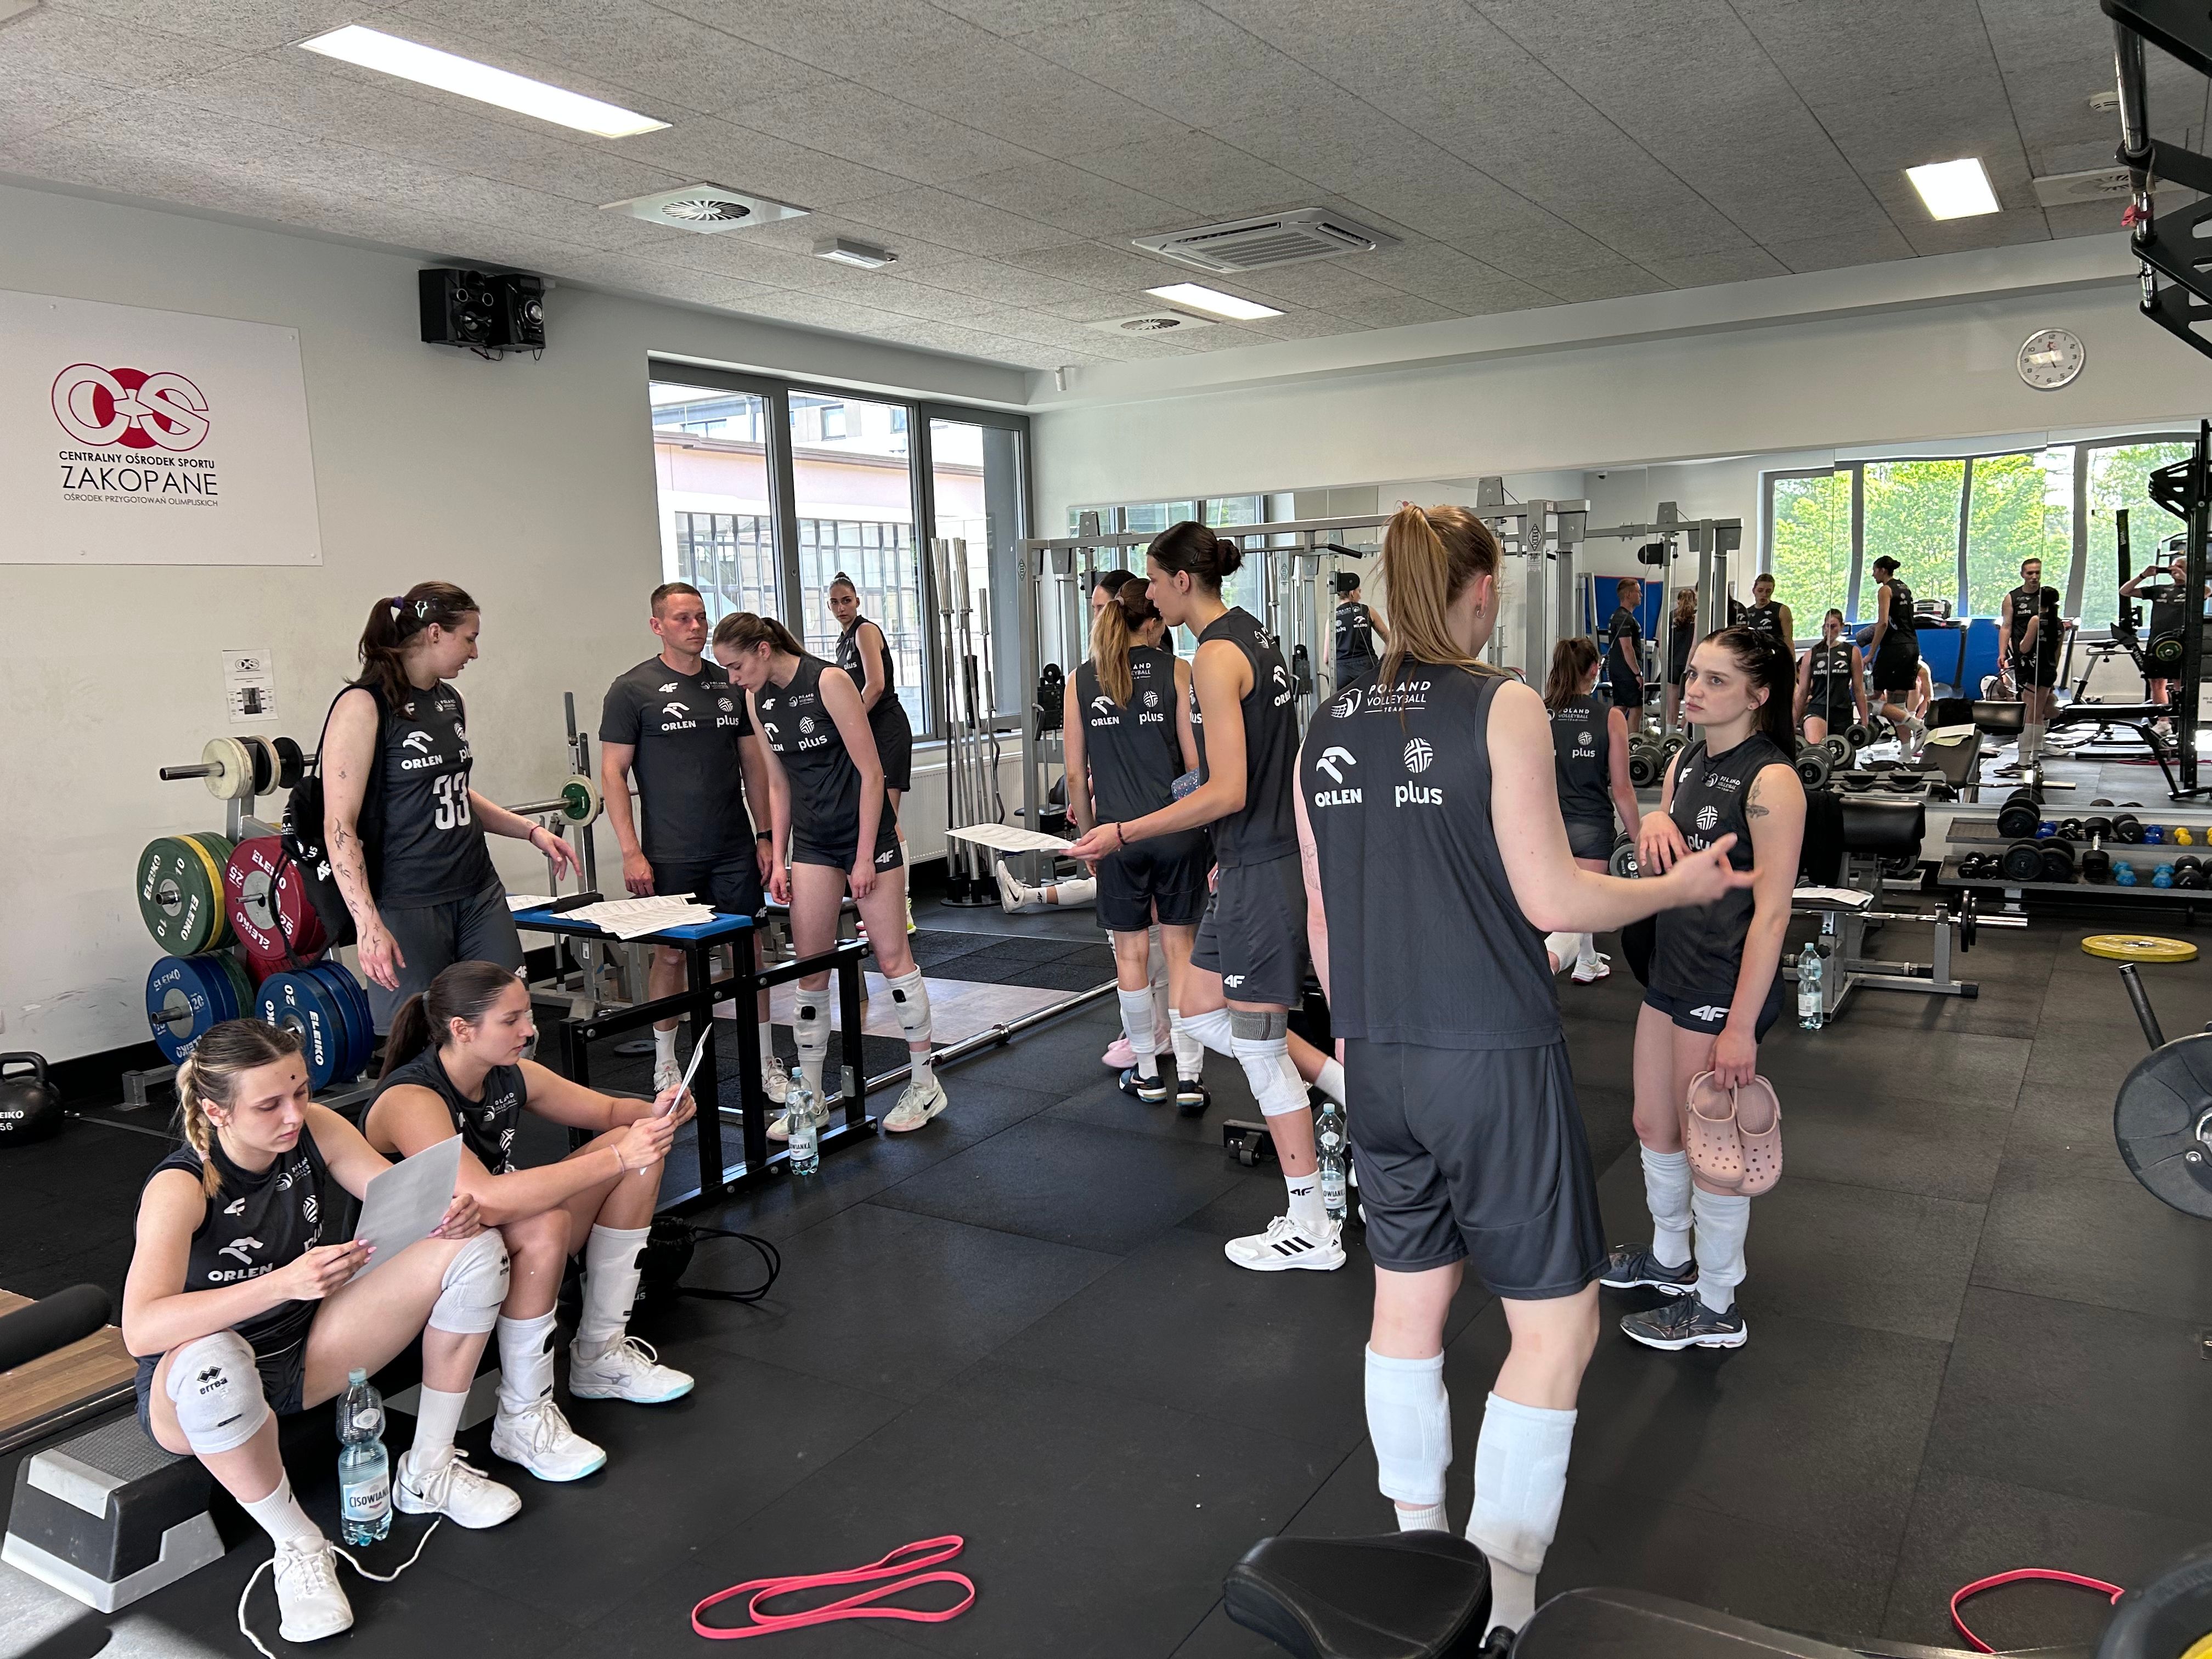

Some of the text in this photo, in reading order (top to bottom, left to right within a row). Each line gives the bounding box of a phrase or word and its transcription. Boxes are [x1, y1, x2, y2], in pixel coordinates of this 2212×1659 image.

[59, 451, 215, 469] CENTRALNY OŚRODEK SPORTU
[61, 465, 218, 495] ZAKOPANE
[64, 493, 218, 506] OŚRODEK PRZYGOTOWAŃ OLIMPIJSKICH
[658, 682, 679, 693] 4F
[761, 698, 776, 710] 4F
[661, 720, 696, 731] ORLEN
[716, 715, 739, 728] plus
[1091, 716, 1120, 727] ORLEN
[1139, 710, 1164, 725] plus
[769, 743, 785, 752] LEN
[798, 735, 827, 751] plus
[1572, 747, 1595, 758] plus
[401, 754, 443, 770] ORLEN
[1679, 768, 1693, 783] F
[432, 771, 471, 830] 33
[1314, 788, 1363, 808] ORLEN
[1395, 780, 1443, 808] plus
[1687, 833, 1711, 851] plu
[874, 849, 894, 864] 4F
[174, 857, 185, 876] 10
[251, 849, 286, 890] ELEIO
[317, 860, 332, 881] 4F
[143, 854, 161, 901] ELEIKO
[229, 865, 244, 887] 25
[180, 894, 199, 941] ELEIKO
[755, 906, 768, 918] 4F
[157, 918, 167, 937] 10
[236, 911, 270, 950] ELEIKO
[1224, 974, 1245, 988] 4F
[191, 995, 205, 1010] 20
[284, 984, 296, 1006] 20
[265, 1000, 275, 1026] IKO
[1690, 1005, 1730, 1022] 4F
[308, 1010, 324, 1066] ELEIKO
[0, 1110, 24, 1119] EIKO
[1290, 1186, 1314, 1196] 4F
[207, 1262, 273, 1282] ORLEN
[349, 1486, 389, 1508] CISOWIAN
